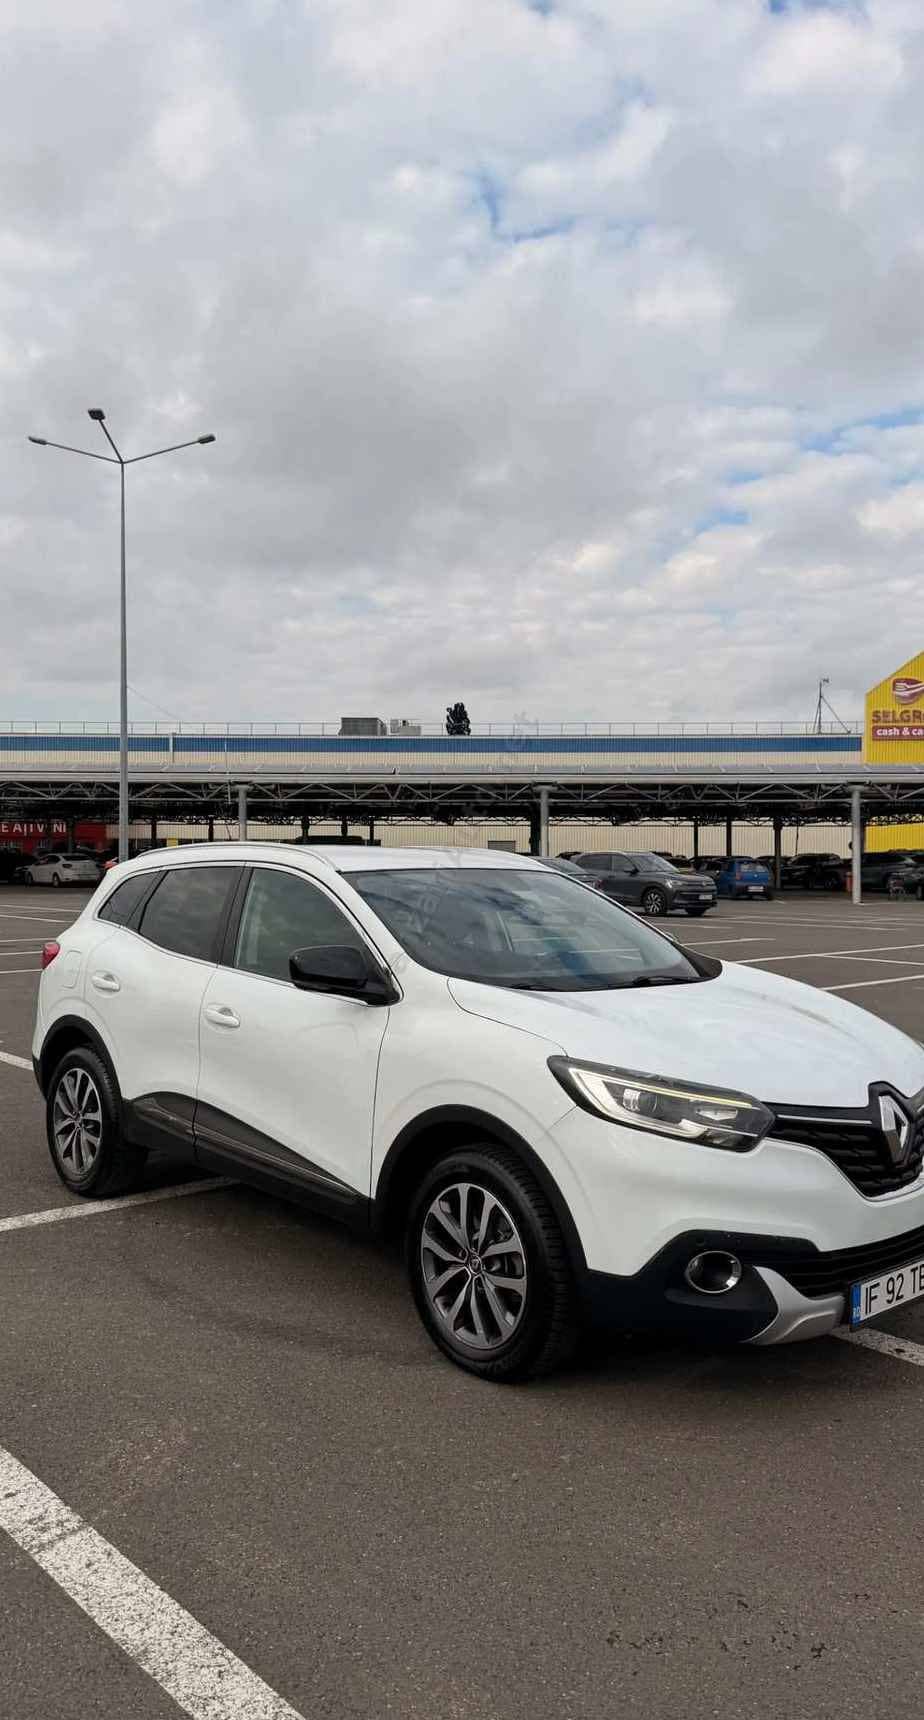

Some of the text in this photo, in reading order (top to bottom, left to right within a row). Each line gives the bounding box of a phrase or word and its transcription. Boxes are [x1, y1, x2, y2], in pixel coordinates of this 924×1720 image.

[872, 710, 924, 723] SELGR
[876, 727, 924, 736] cash & ca
[865, 1283, 880, 1315] IF
[886, 1273, 904, 1304] 92
